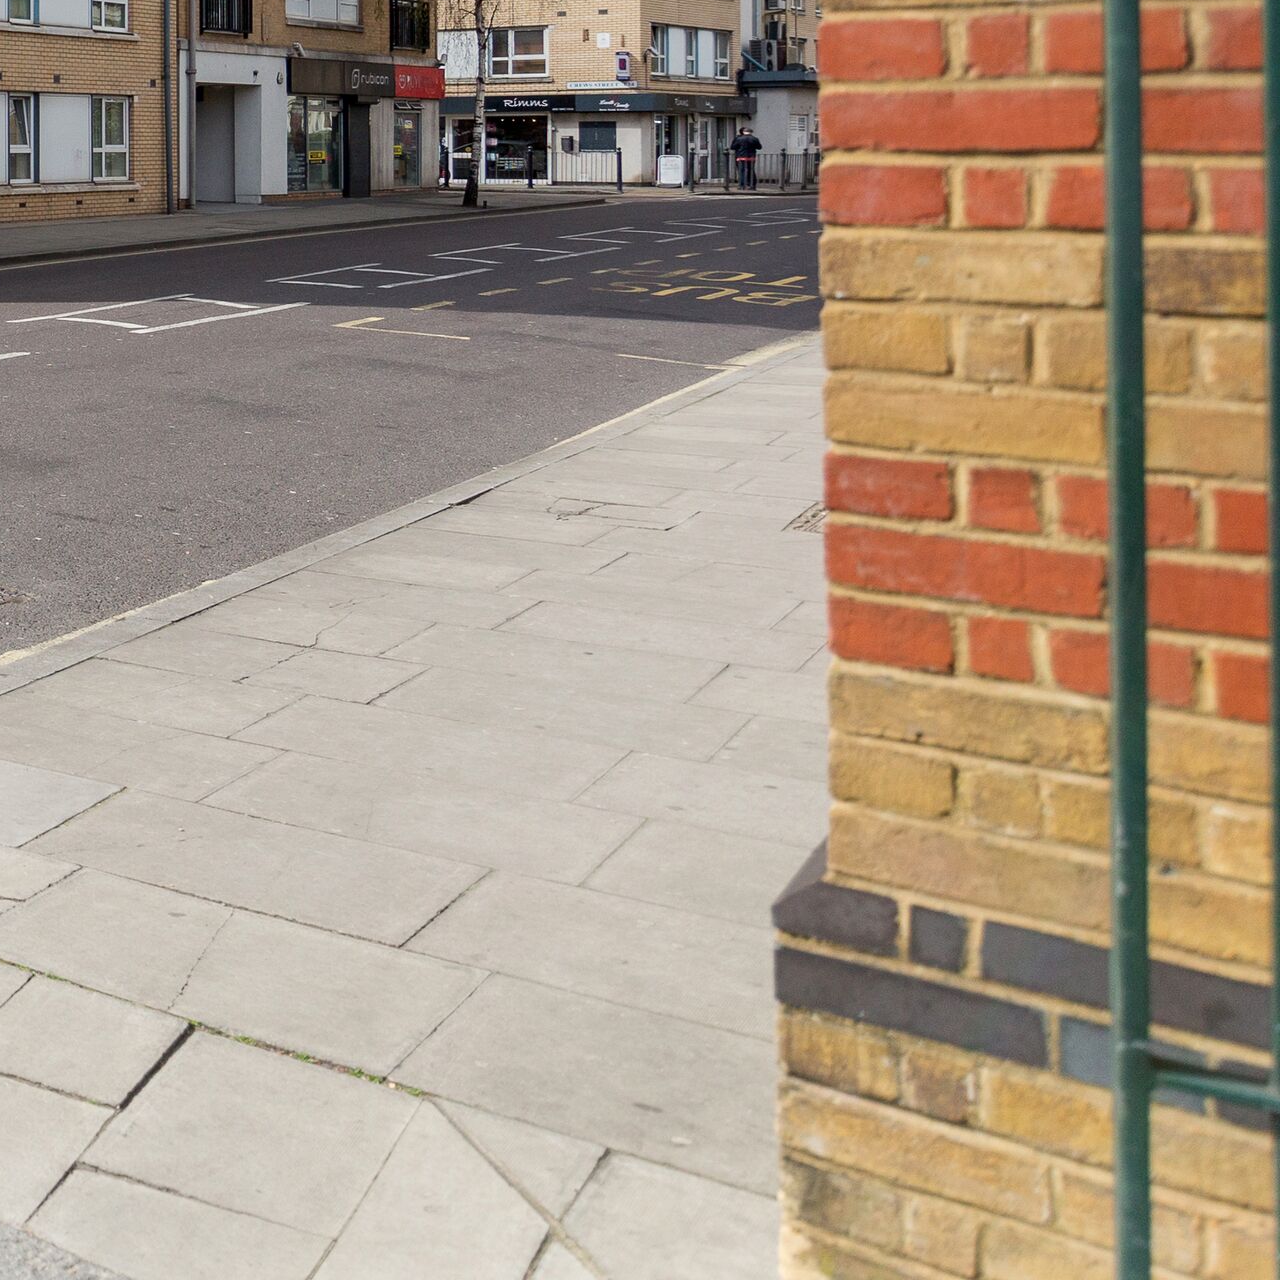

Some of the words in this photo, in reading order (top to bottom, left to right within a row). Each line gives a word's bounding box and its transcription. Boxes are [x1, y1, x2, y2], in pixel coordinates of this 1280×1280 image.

[360, 74, 389, 85] rubicon
[503, 99, 549, 108] Rimms
[592, 281, 818, 307] BUS
